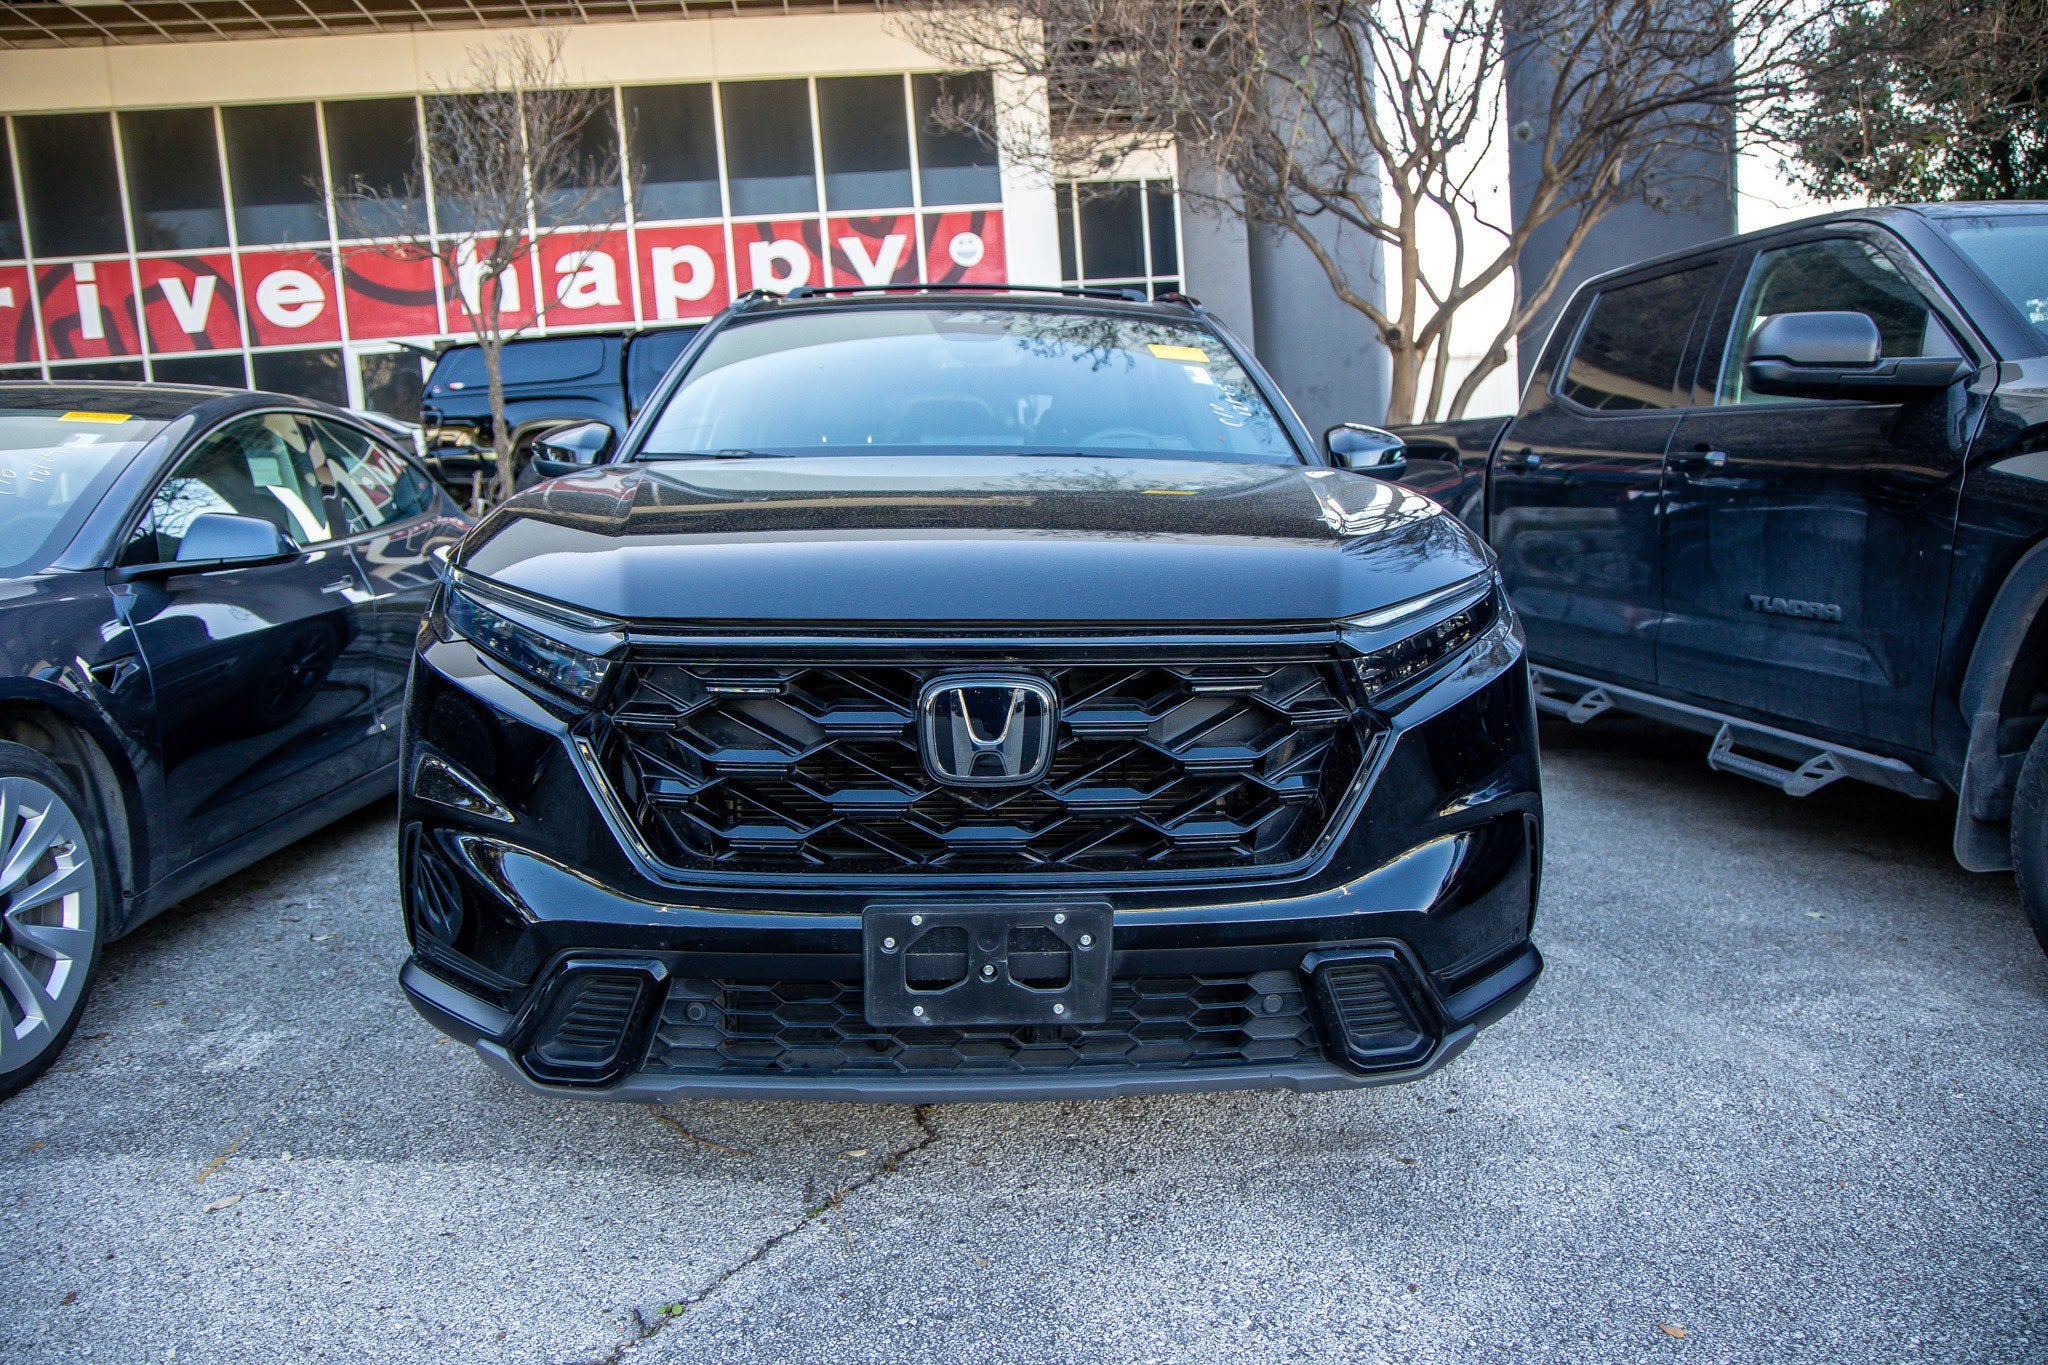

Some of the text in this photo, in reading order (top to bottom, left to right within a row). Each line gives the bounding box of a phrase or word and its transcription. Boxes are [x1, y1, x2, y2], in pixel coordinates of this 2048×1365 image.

[0, 233, 908, 340] ive happy
[1748, 594, 1842, 621] TUNDRA
